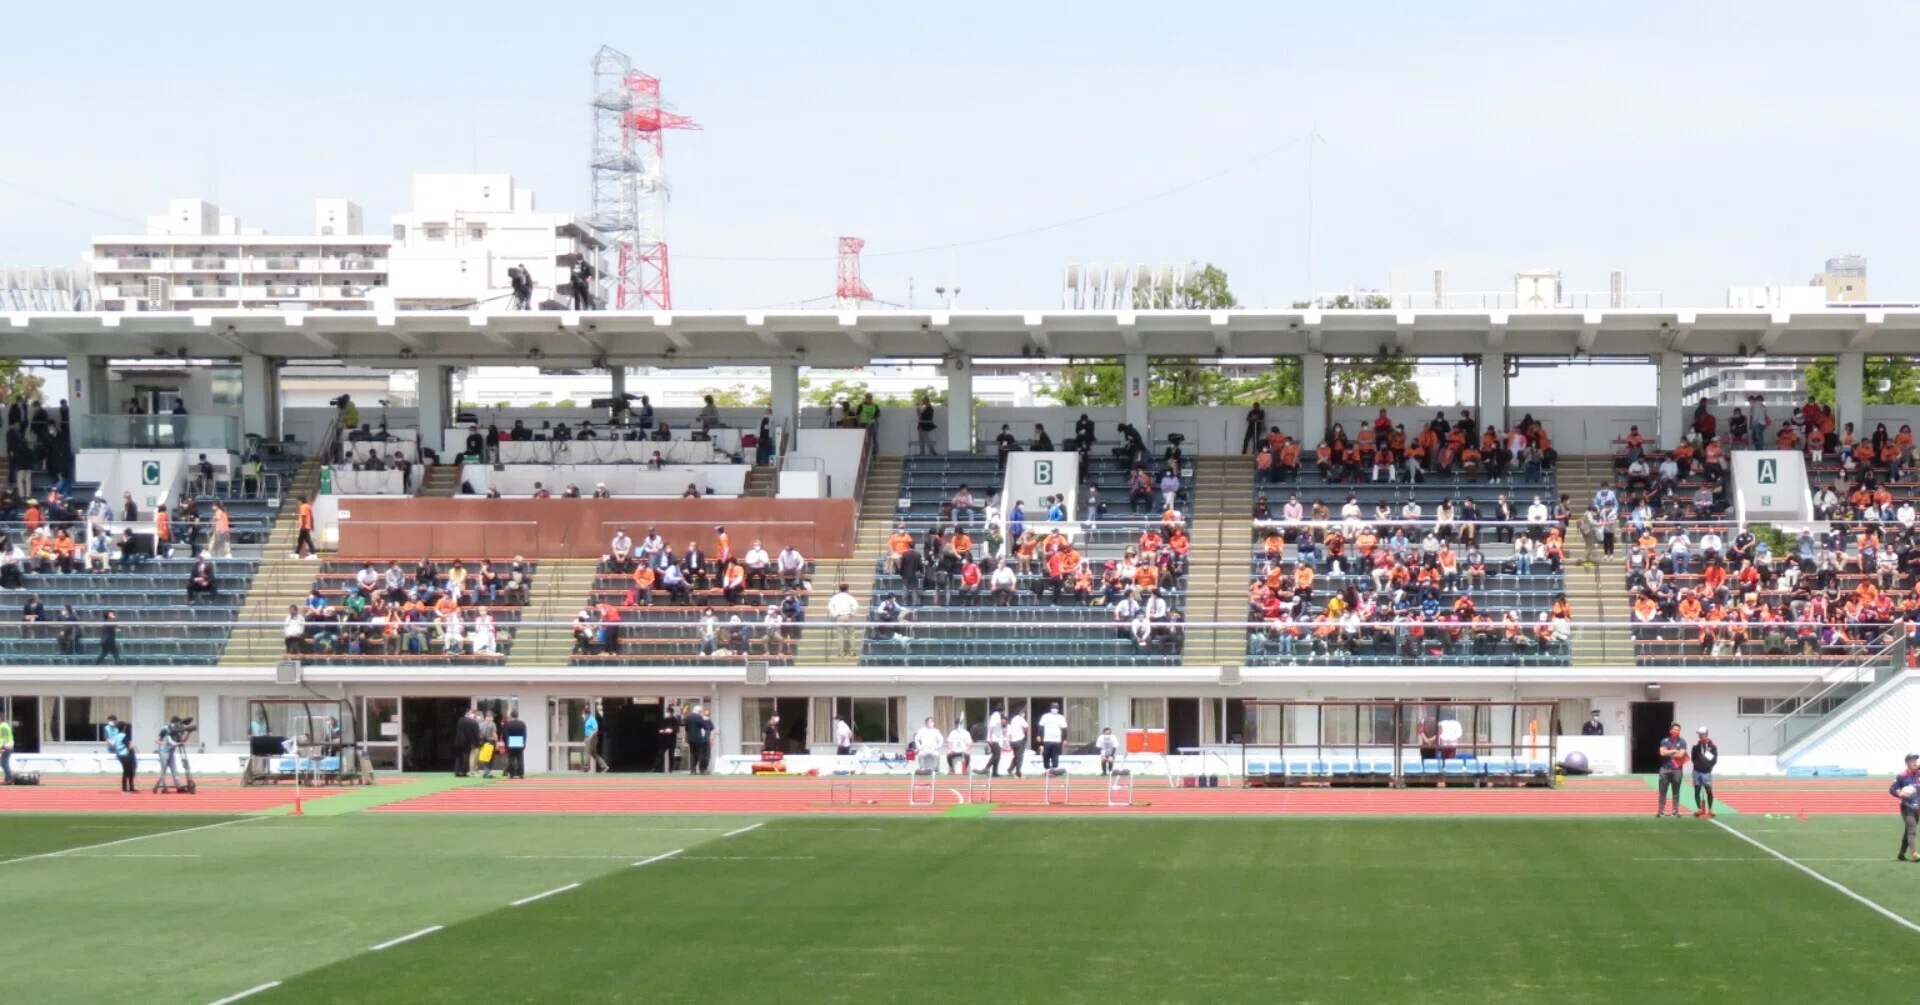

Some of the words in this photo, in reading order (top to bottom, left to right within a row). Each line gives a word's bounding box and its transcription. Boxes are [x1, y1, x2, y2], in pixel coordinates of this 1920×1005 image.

[143, 462, 159, 485] C
[1036, 461, 1051, 484] B
[1759, 460, 1775, 482] A
